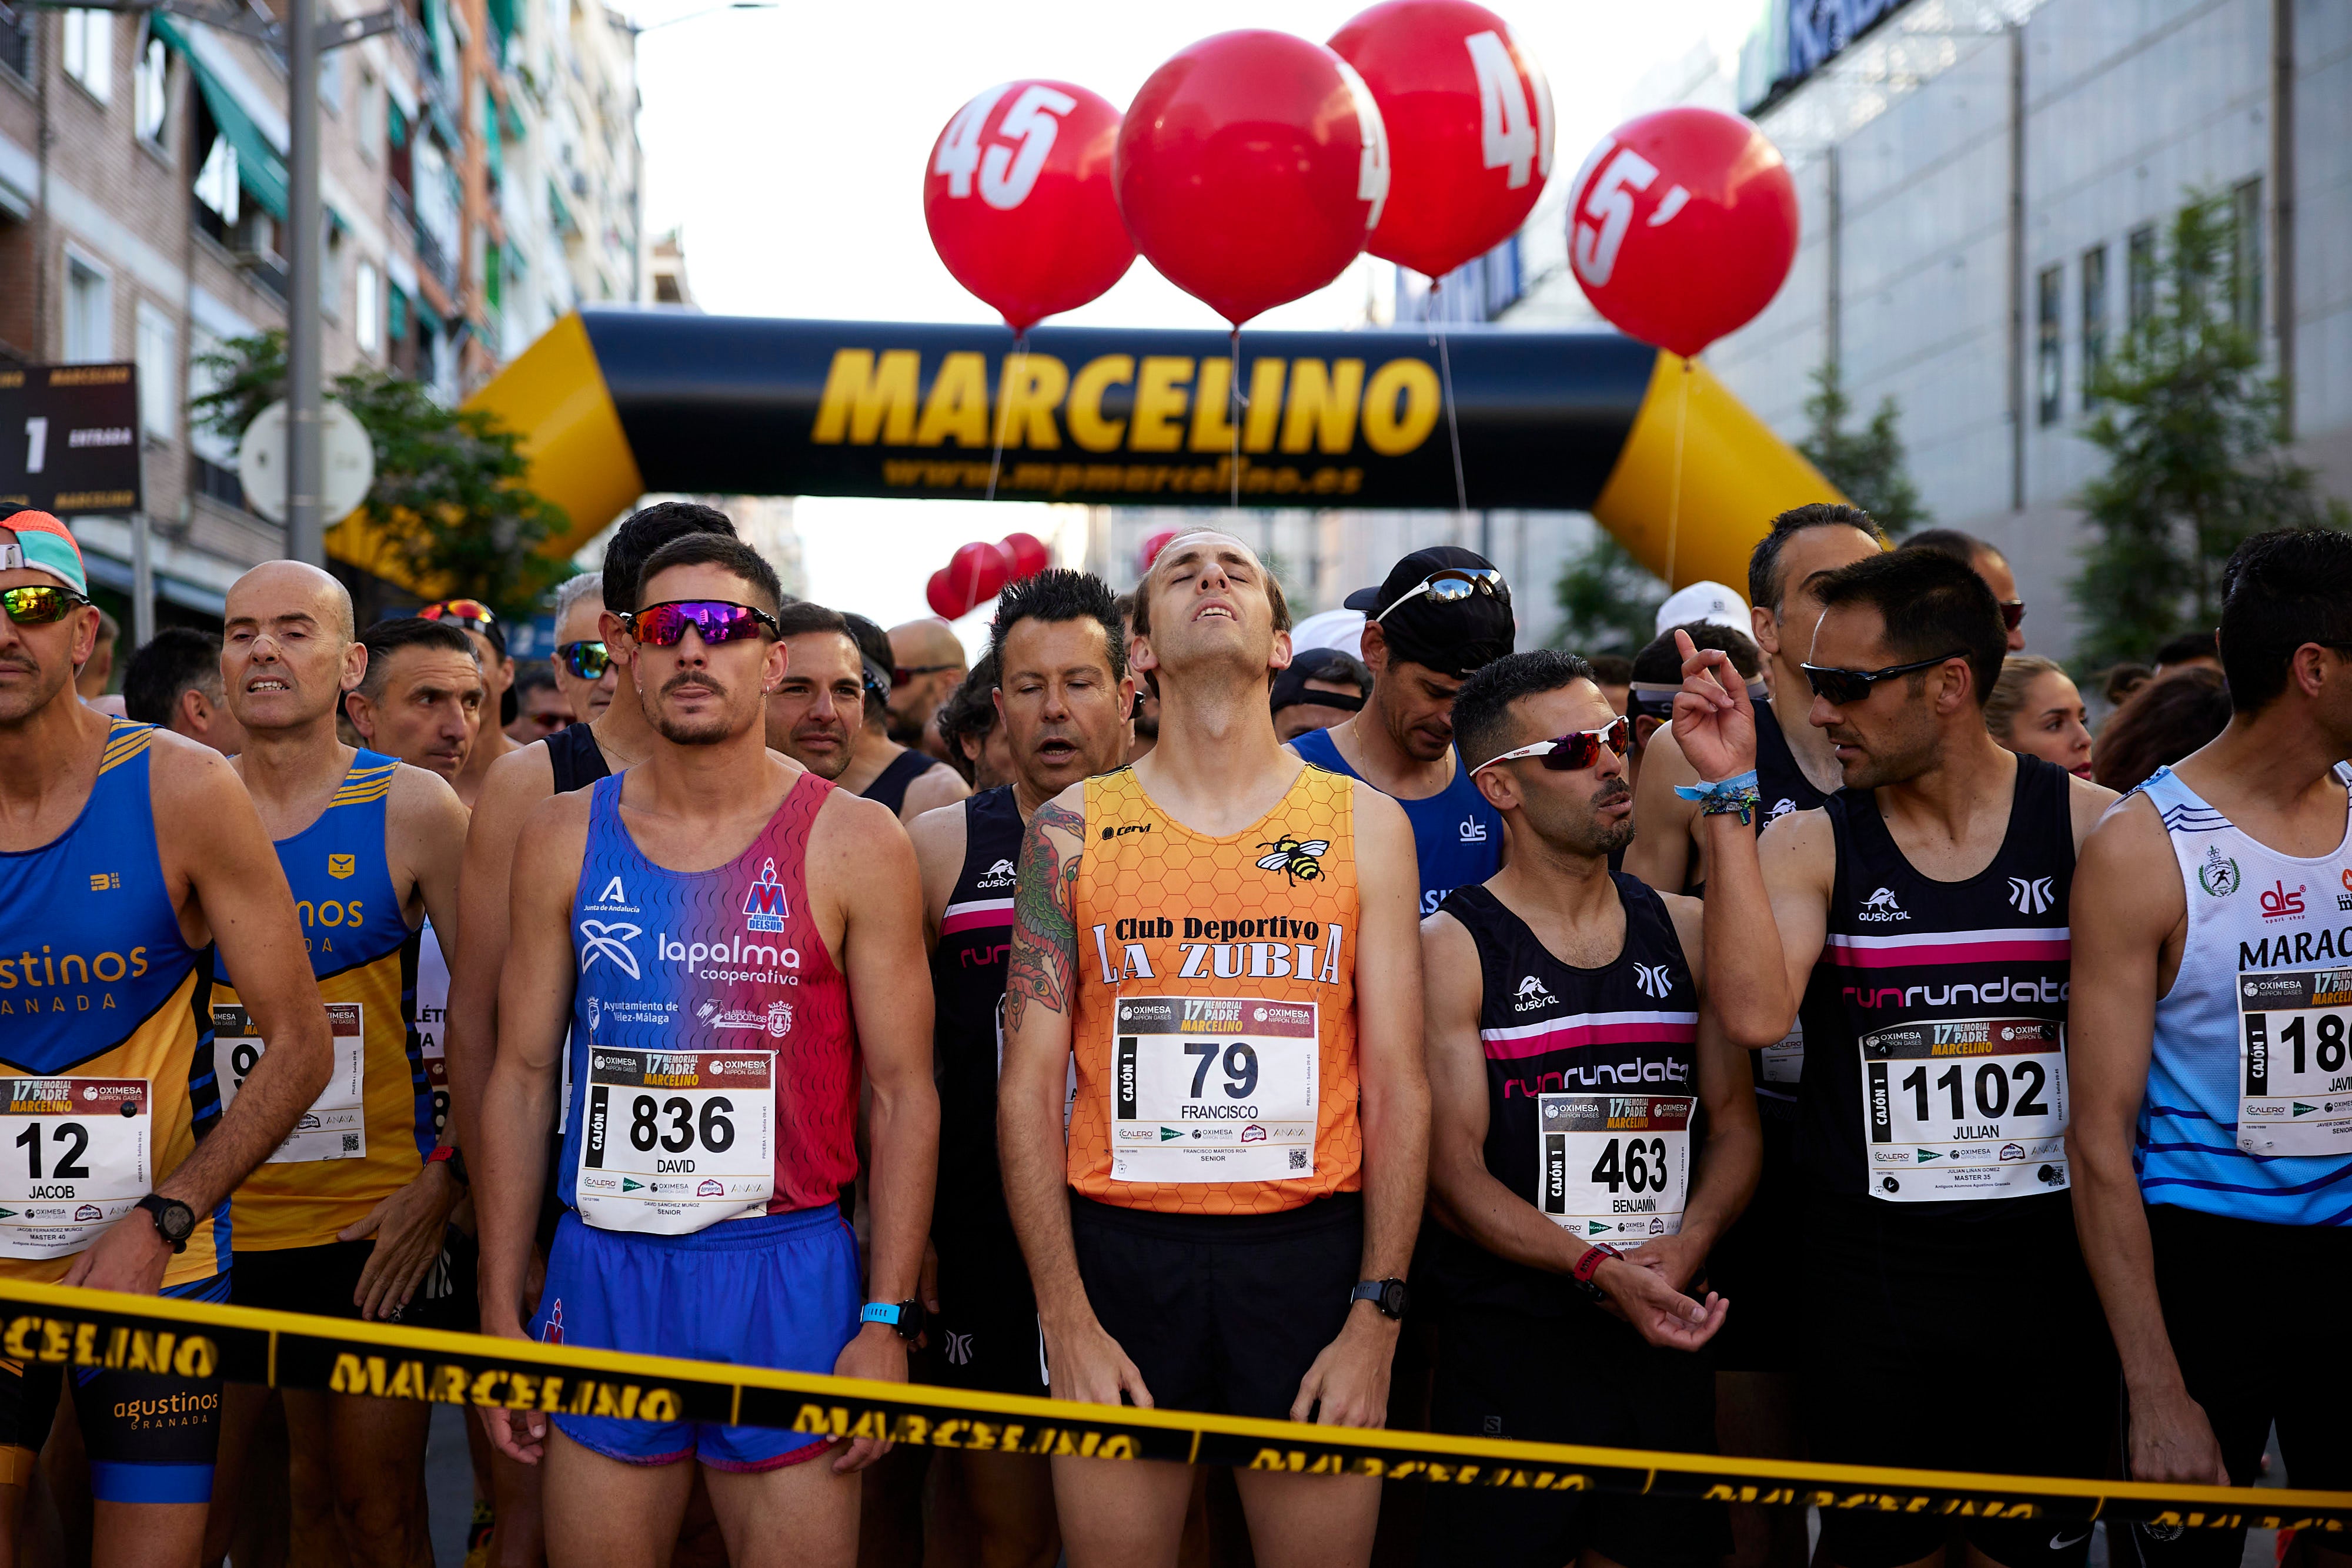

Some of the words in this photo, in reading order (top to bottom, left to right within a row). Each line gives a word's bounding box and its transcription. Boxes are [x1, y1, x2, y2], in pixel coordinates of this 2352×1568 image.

[934, 82, 1078, 210] 45
[812, 348, 1442, 456] MARCELINO
[25, 416, 49, 474] 1
[883, 456, 1362, 496] www.mpmarcelino.es
[609, 905, 640, 914] Andalucía
[1858, 912, 1912, 922] austral
[749, 920, 783, 931] DELSUR
[1116, 917, 1174, 941] Club
[1183, 915, 1319, 942] Deportivo
[659, 932, 801, 973] lapalma
[1093, 923, 1155, 985] LA
[1178, 923, 1344, 985] ZUBIA
[700, 969, 799, 986] cooperativa
[2260, 981, 2302, 989] OXIMESA
[2314, 972, 2333, 994] 17
[1515, 995, 1560, 1012] austral
[2311, 991, 2352, 1005] MARCELI
[603, 1001, 664, 1012] Ayuntamiento
[666, 1002, 679, 1012] de
[1133, 1006, 1171, 1014] OXIMESA
[1184, 1000, 1205, 1020] 17
[1204, 1000, 1242, 1010] MEMORIAL
[1268, 1008, 1310, 1018] OXIMESA
[613, 1012, 670, 1024] Vélez-Málaga
[724, 1011, 767, 1022] deportes
[1204, 1009, 1240, 1021] PADRE
[1180, 1020, 1244, 1032] MARCELINO
[1934, 1025, 1953, 1044] 17
[1953, 1022, 1990, 1032] MEMORIAL
[1880, 1032, 1922, 1041] OXIMESA
[1954, 1031, 1989, 1043] PADRE
[2281, 1014, 2352, 1074] 18
[1931, 1041, 1993, 1056] MARCELINO
[606, 1057, 637, 1067] OXIMESA
[646, 1054, 662, 1074] 17
[662, 1055, 699, 1064] MEMORIAL
[724, 1061, 766, 1069] OXIMESA
[2252, 1041, 2265, 1078] CAJÓN
[663, 1062, 696, 1075] PADRE
[1184, 1042, 1259, 1099] 79
[644, 1074, 699, 1086] MARCELINO
[1120, 1064, 1134, 1102] CAJÓN
[2328, 1077, 2352, 1092] JAVI
[13, 1081, 34, 1101] 17
[32, 1081, 72, 1089] MEMORIAL
[33, 1089, 69, 1101] PADRE
[1902, 1061, 2049, 1121] 1102
[9, 1100, 72, 1112] MARCELINO
[1181, 1105, 1258, 1119] FRANCISCO
[1609, 1098, 1625, 1117] 17
[1624, 1098, 1649, 1106] MEMORIAL
[1624, 1106, 1647, 1117] PADRE
[1872, 1089, 1886, 1125] CAJÓN
[630, 1095, 735, 1154] 836
[1606, 1117, 1649, 1129] MARCELINO
[592, 1113, 605, 1150] CAJÓN
[1273, 1128, 1306, 1136] ANAYA
[1953, 1125, 1999, 1140] JULIAN
[16, 1122, 89, 1179] 12
[657, 1159, 696, 1173] DAVID
[1591, 1138, 1668, 1193] 463
[587, 1178, 616, 1186] CALERO
[1549, 1161, 1562, 1197] CAJÓN
[29, 1185, 75, 1199] JACOB
[1613, 1196, 1656, 1213] BENJAMÍN
[328, 1352, 683, 1423] MARCELINO
[113, 1391, 218, 1423] agustinos
[131, 1414, 208, 1430] GRANADA
